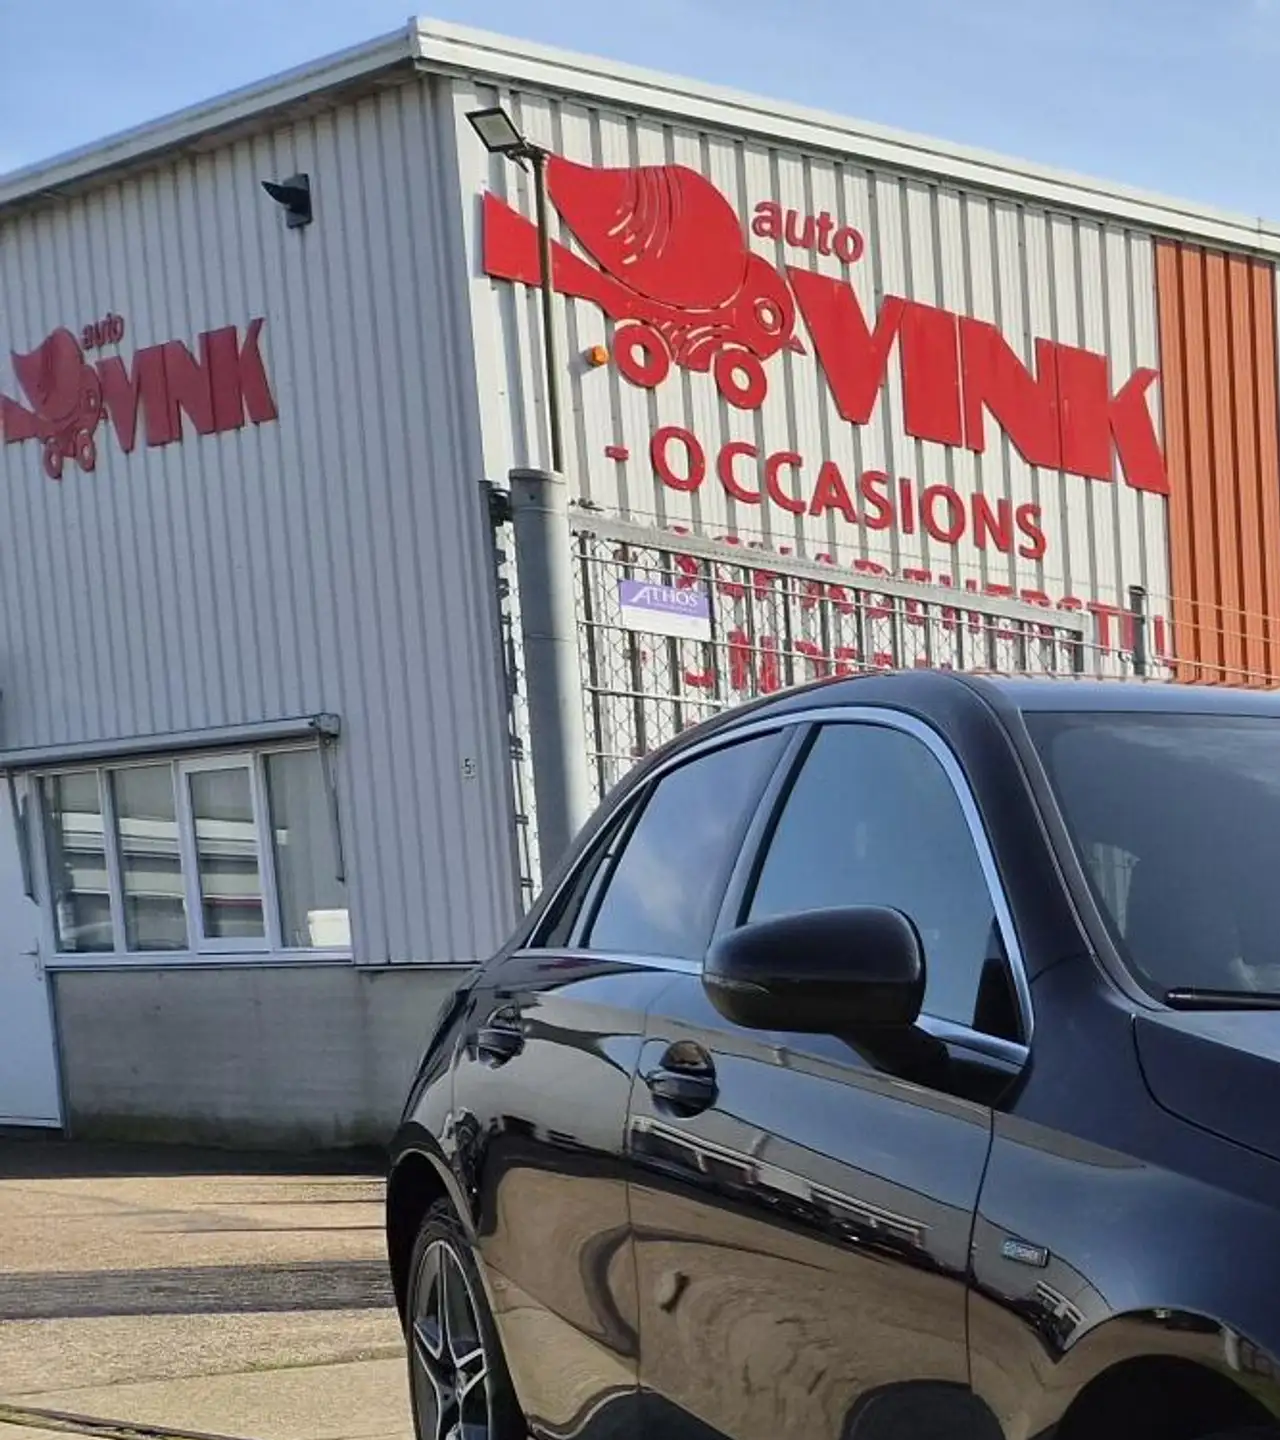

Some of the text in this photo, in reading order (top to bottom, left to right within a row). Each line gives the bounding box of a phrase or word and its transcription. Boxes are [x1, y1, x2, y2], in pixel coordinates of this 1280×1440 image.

[752, 201, 864, 264] auto
[82, 312, 124, 351] auto
[786, 265, 1171, 496] VINK
[95, 317, 279, 454] VINK
[650, 425, 1047, 561] OCCASIONS
[630, 586, 699, 607] ATHOS
